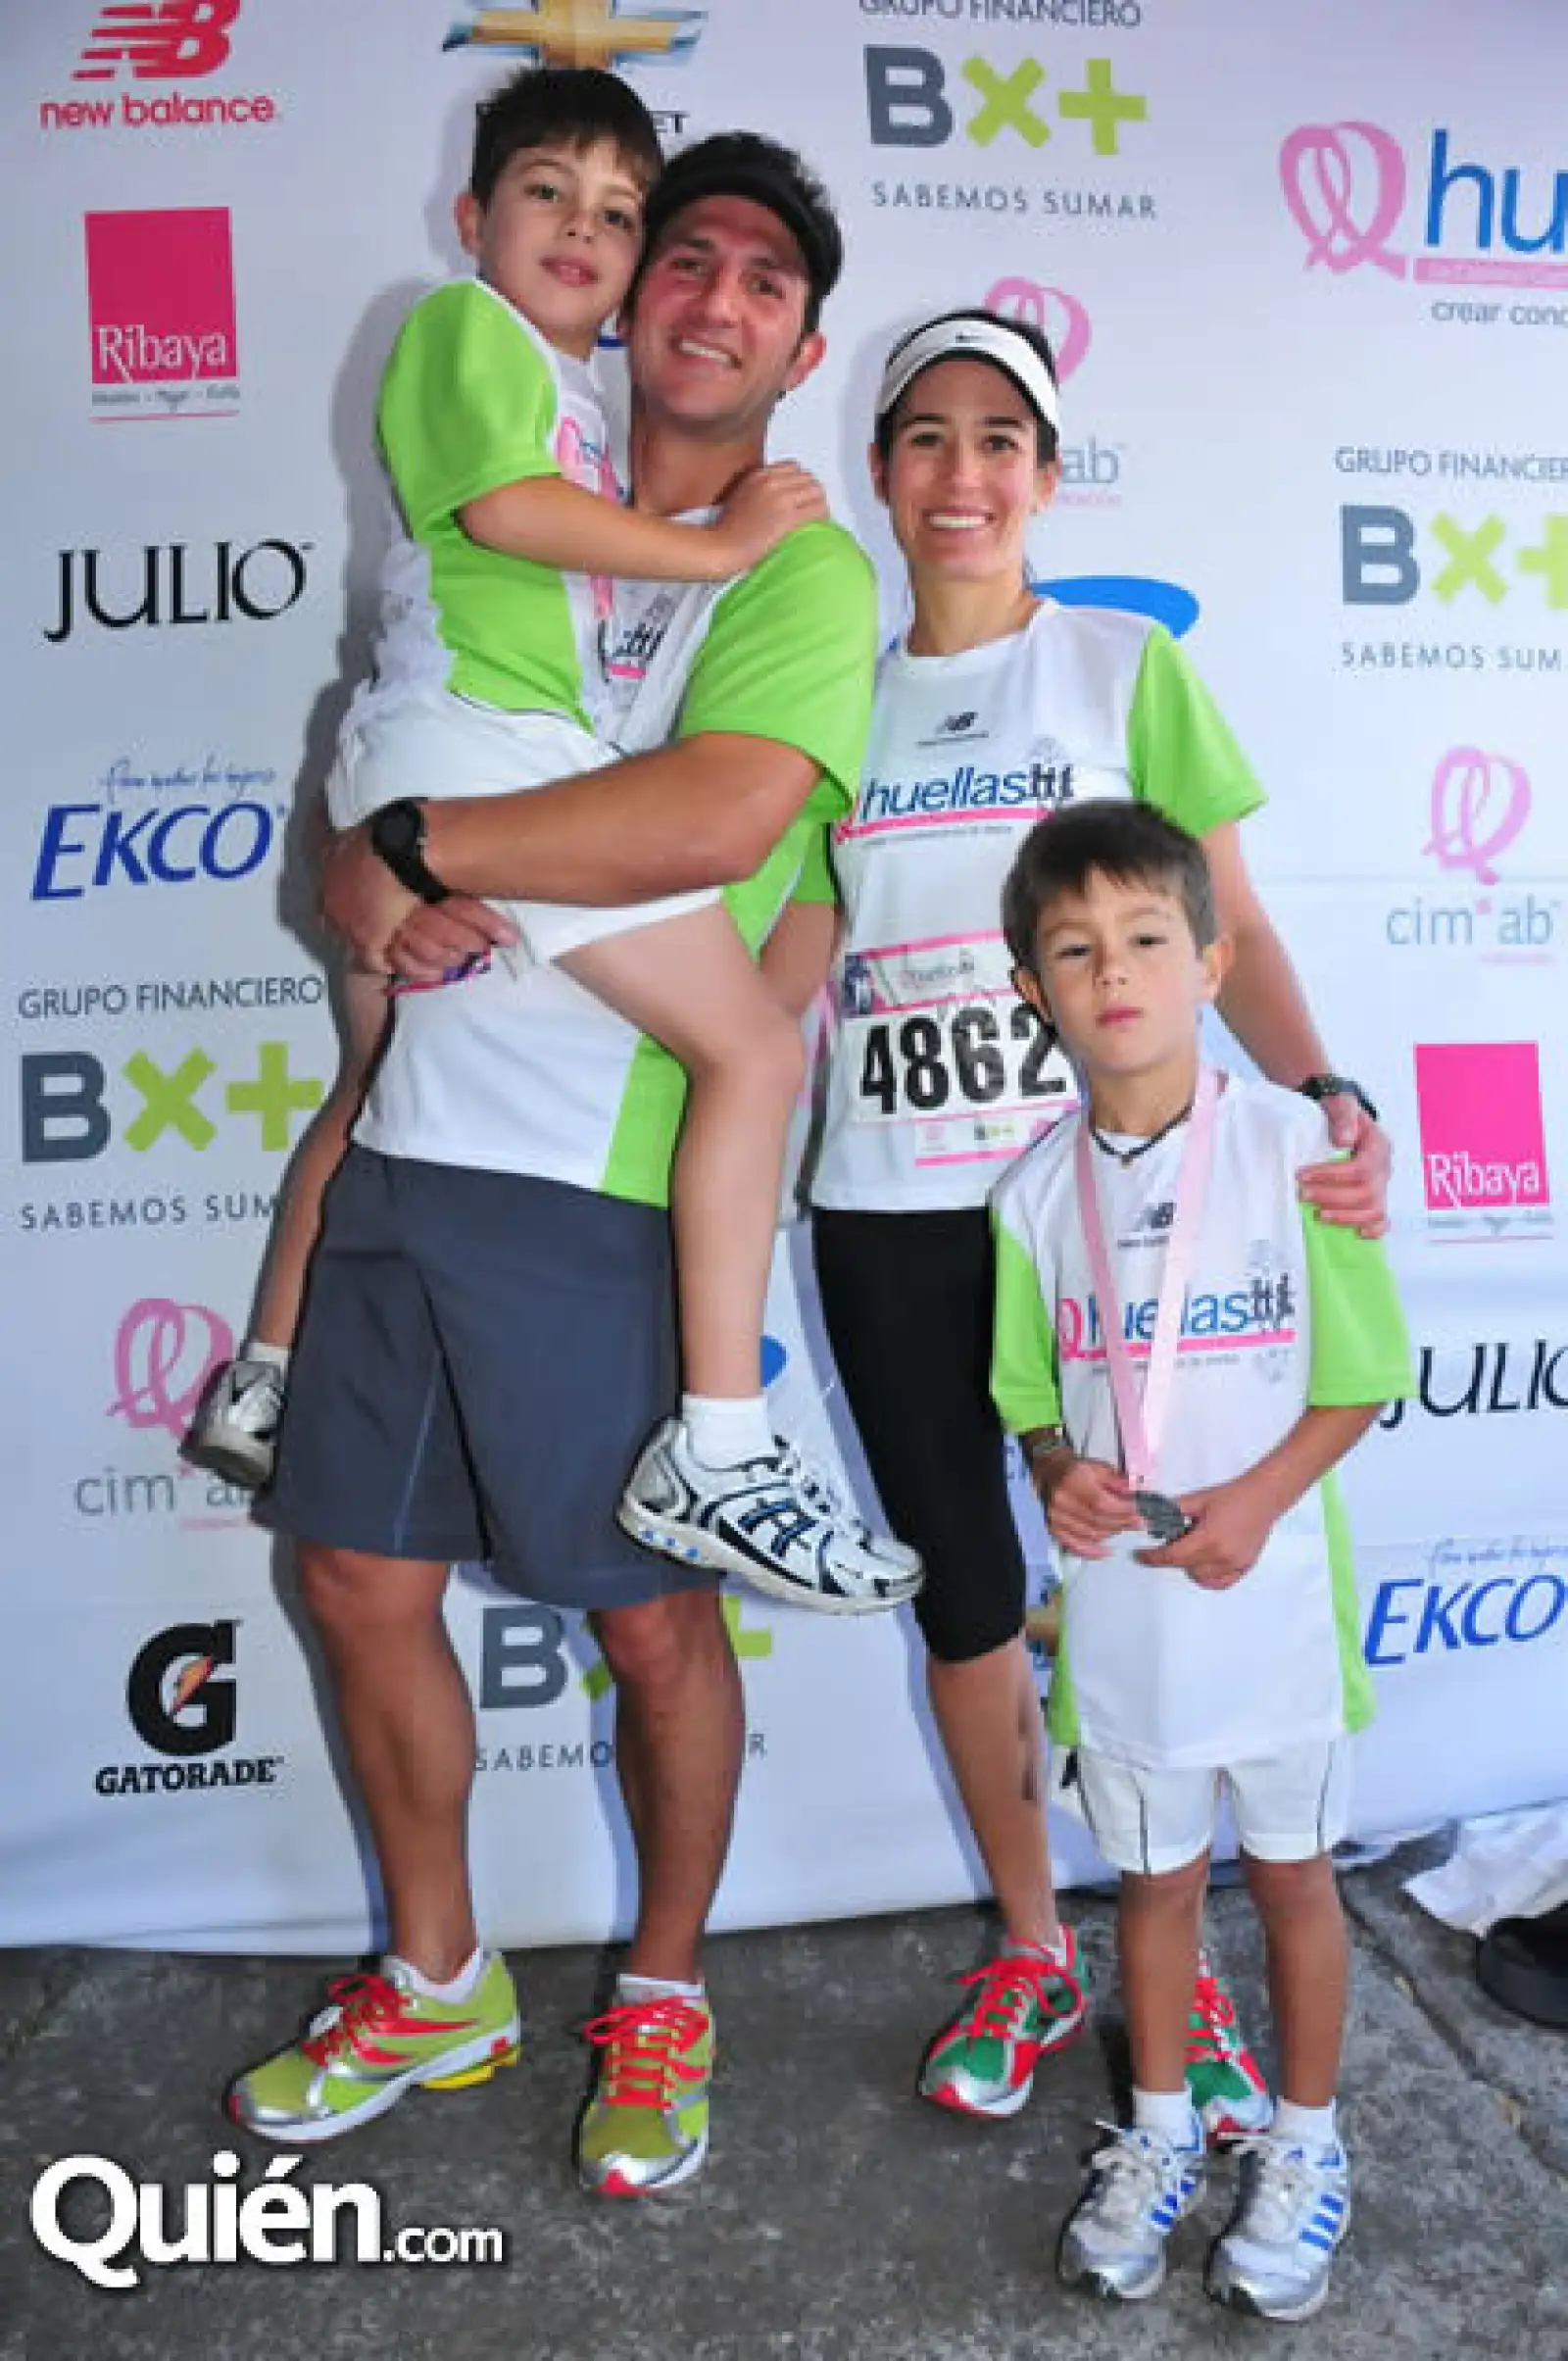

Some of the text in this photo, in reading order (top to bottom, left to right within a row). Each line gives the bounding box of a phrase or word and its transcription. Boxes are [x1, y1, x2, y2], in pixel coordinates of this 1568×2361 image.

[40, 91, 274, 128] new balance
[871, 180, 1157, 219] SABEMOS SUMAR
[97, 323, 227, 384] Ribaya
[1334, 446, 1432, 476] GRUPO
[44, 539, 307, 642] JULIO
[1341, 641, 1568, 671] SABEMOS SUM
[858, 765, 1027, 823] huellas
[29, 800, 274, 901] EKCO
[18, 975, 324, 1019] GRUPO FINANCIERO
[859, 1003, 1072, 1115] 4862
[1426, 1150, 1541, 1209] Ribaya
[22, 1192, 279, 1229] SABEMOS SUM
[1363, 1574, 1568, 1666] EKCO
[95, 1756, 278, 1796] GATORADE
[475, 1739, 612, 1772] SABEMO
